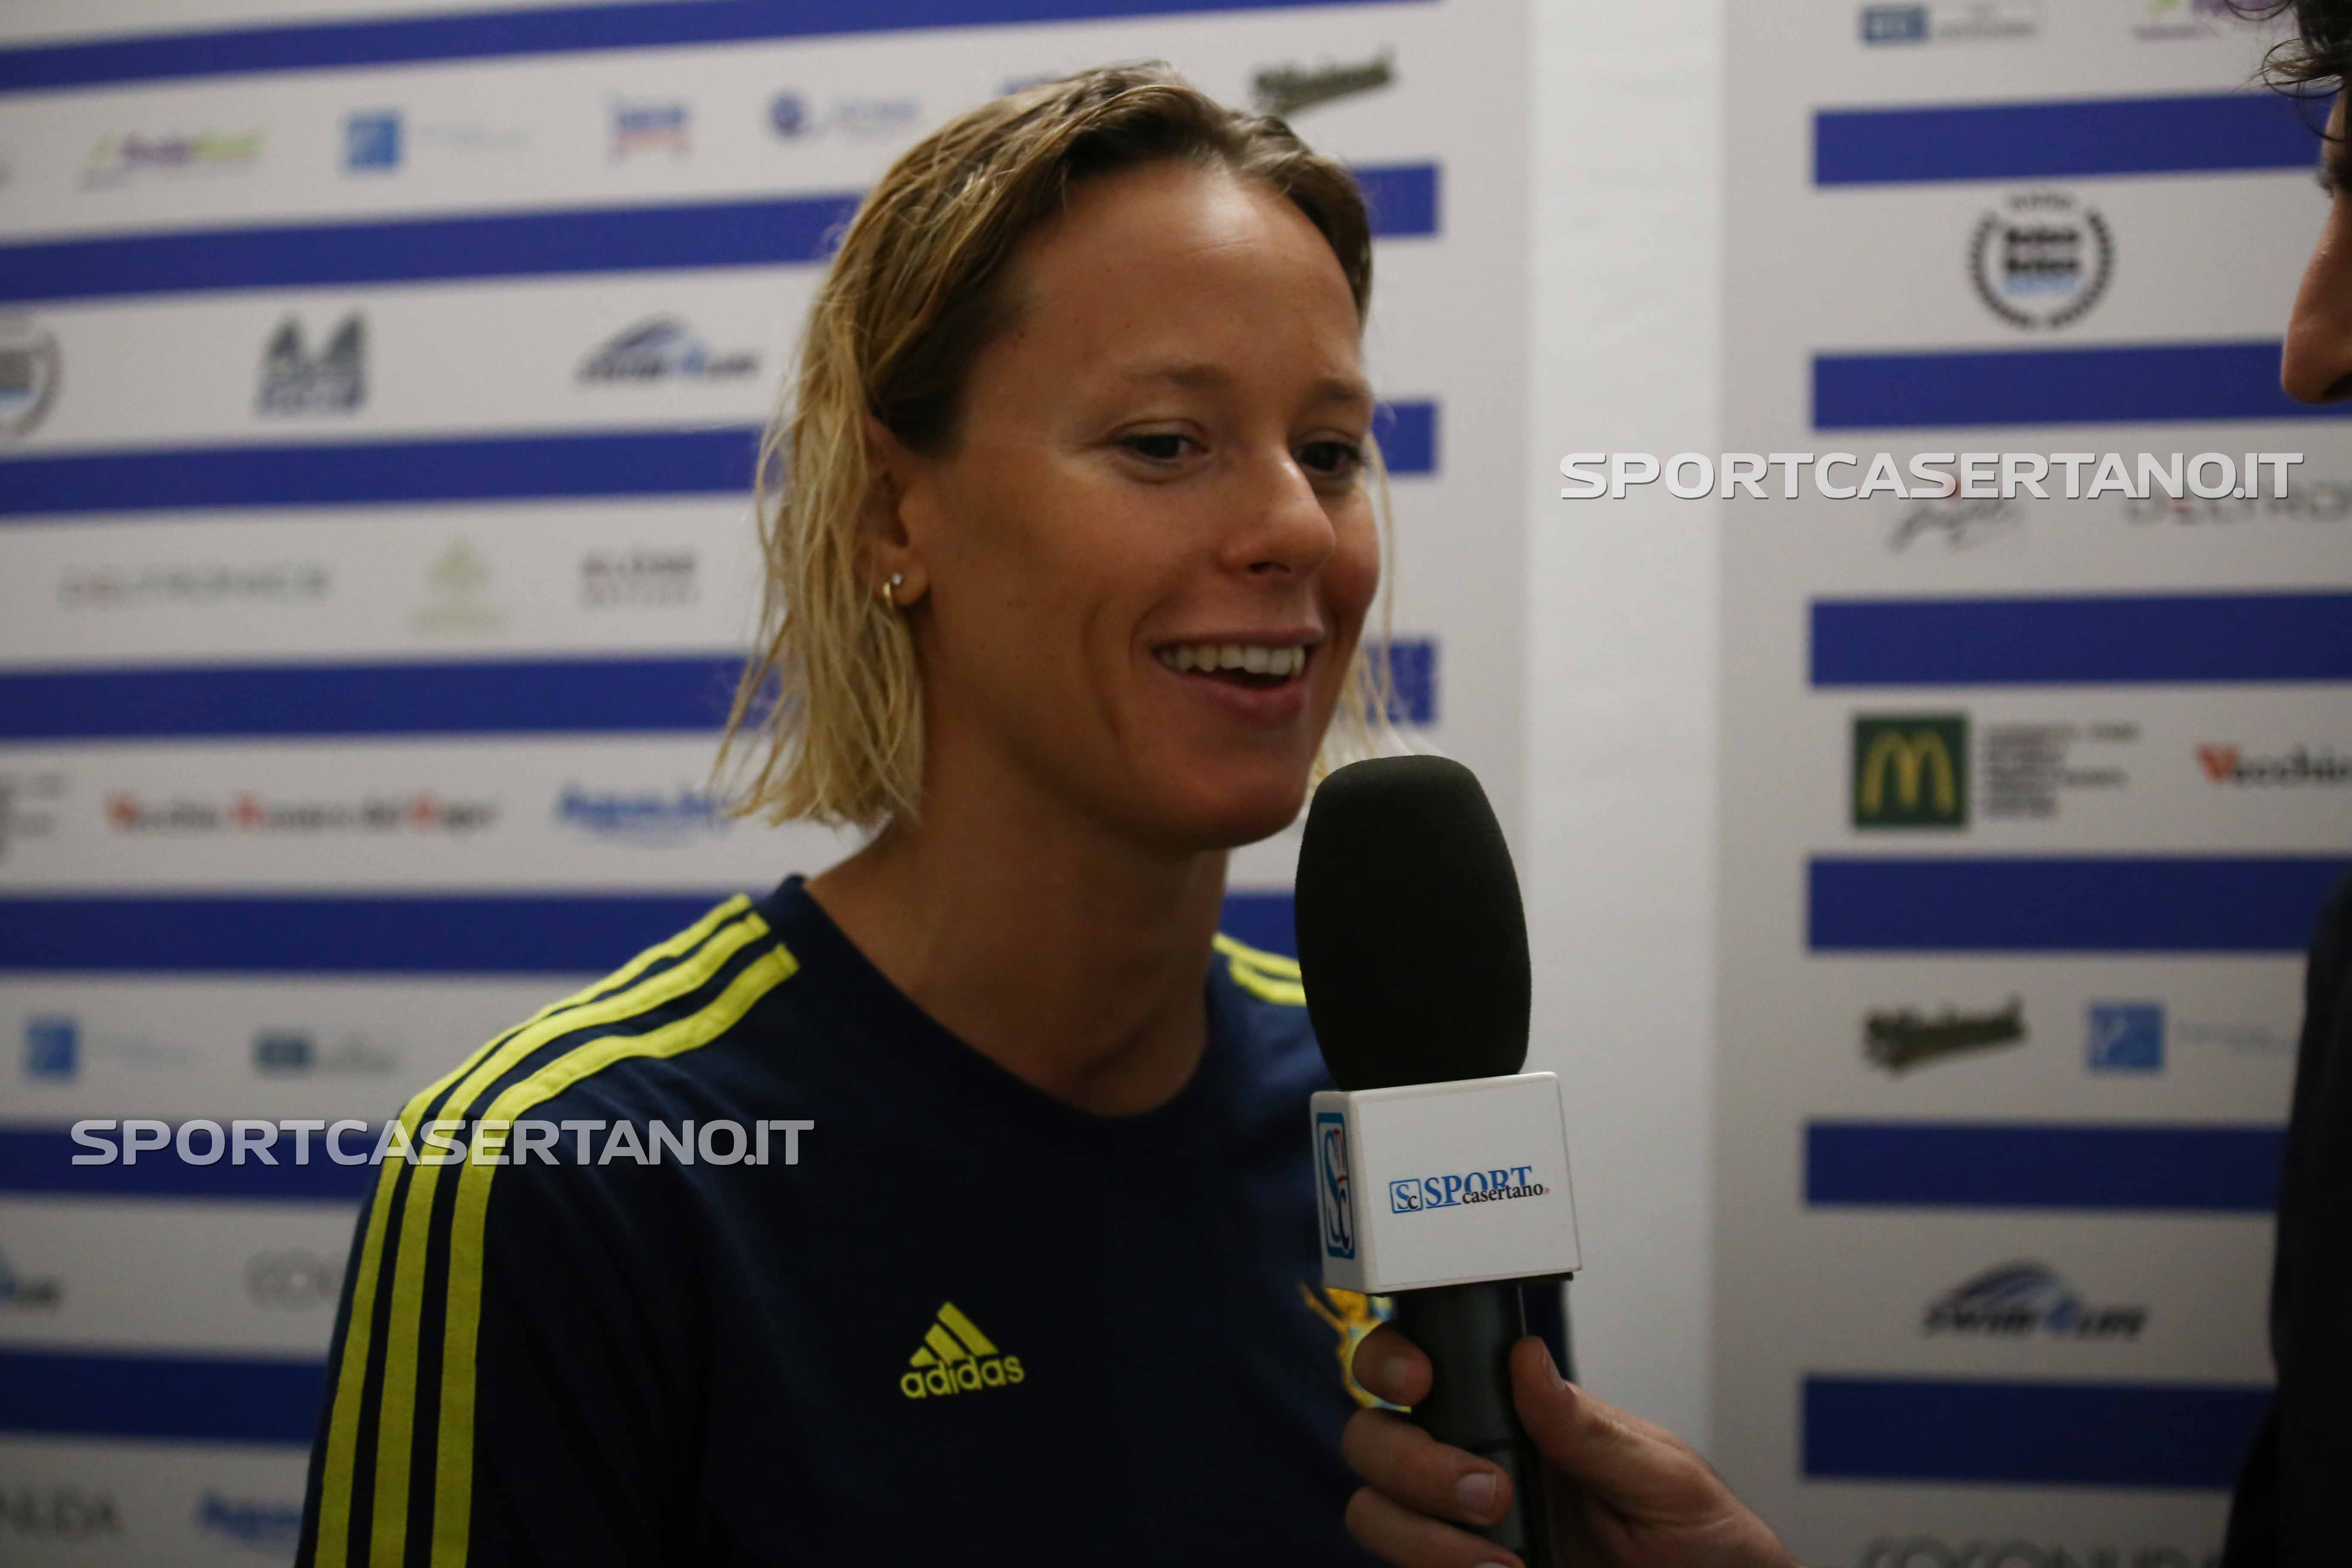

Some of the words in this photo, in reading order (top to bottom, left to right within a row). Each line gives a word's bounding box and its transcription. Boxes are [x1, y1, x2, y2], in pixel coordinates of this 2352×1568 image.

[1424, 1165, 1532, 1208] SPORT
[1462, 1183, 1544, 1204] casertano
[900, 1355, 1025, 1399] adidas
